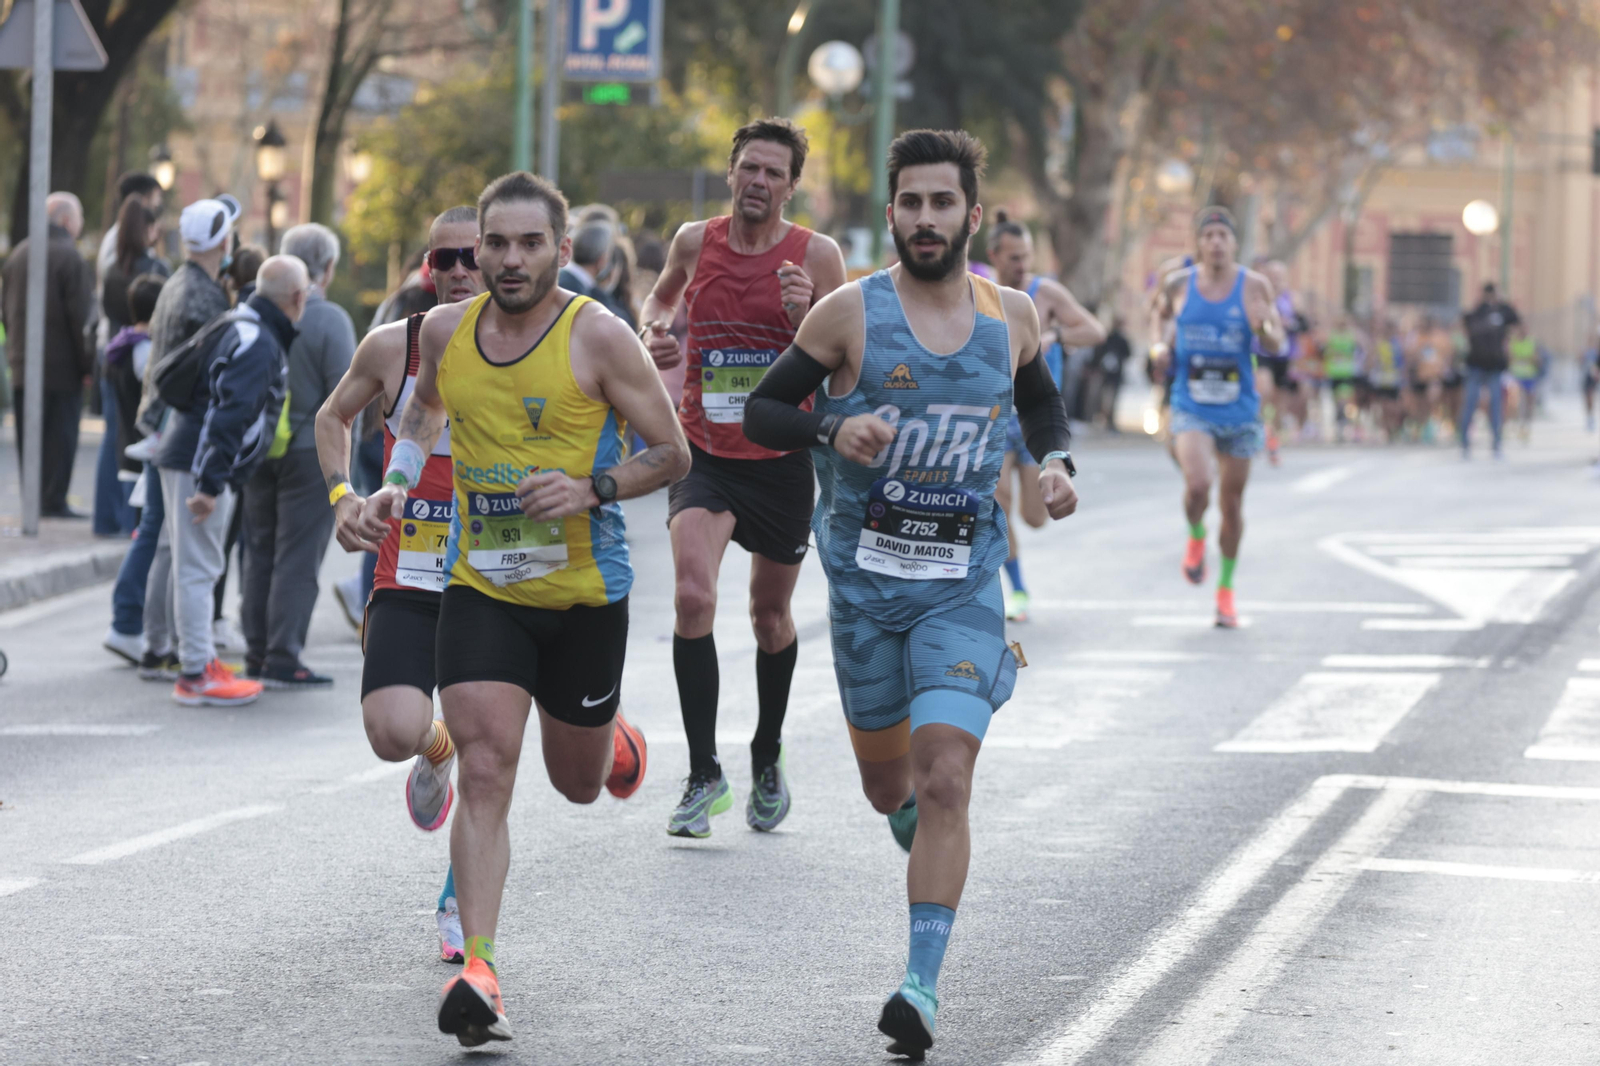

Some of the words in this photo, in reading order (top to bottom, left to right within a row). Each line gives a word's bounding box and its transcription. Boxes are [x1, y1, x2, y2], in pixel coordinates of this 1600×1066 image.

[578, 0, 632, 50] P
[726, 353, 770, 364] ZURICH
[731, 376, 750, 388] 941
[903, 470, 948, 482] SPORTS
[907, 490, 968, 507] ZURICH
[900, 518, 938, 536] 2752
[502, 528, 522, 543] 931
[876, 536, 910, 555] DAVID
[914, 545, 954, 559] MATOS
[500, 552, 527, 565] FRED
